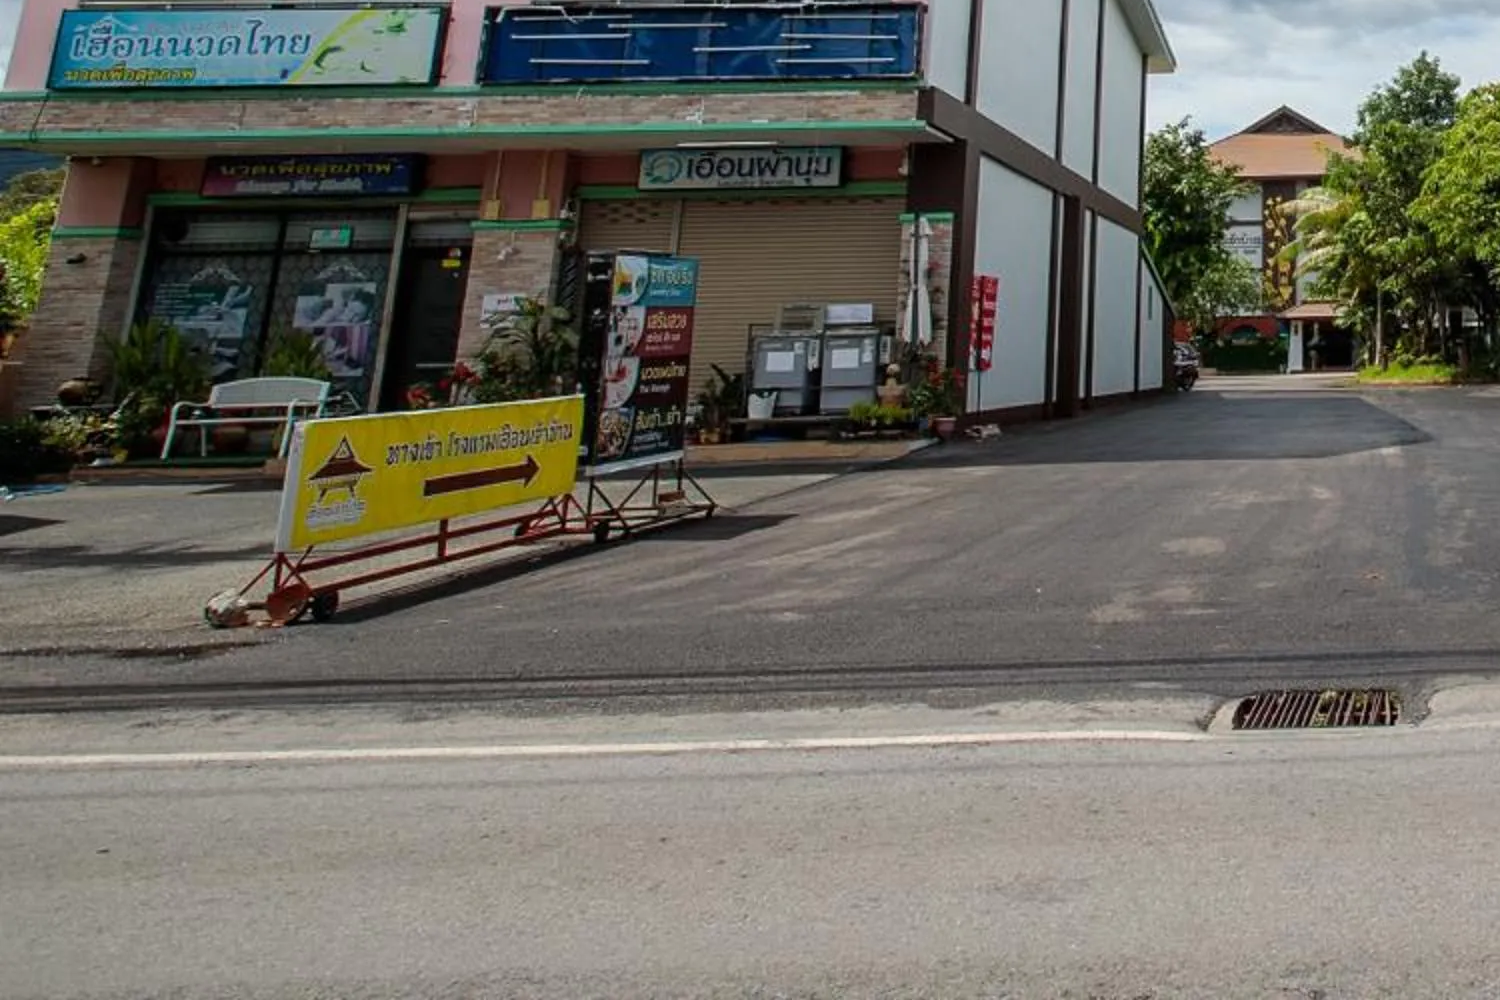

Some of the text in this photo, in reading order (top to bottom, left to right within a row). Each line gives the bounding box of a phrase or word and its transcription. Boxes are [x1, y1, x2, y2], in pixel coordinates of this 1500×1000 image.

[71, 18, 312, 58] เฮือนนวดไทย
[385, 433, 443, 466] ทางเข้า
